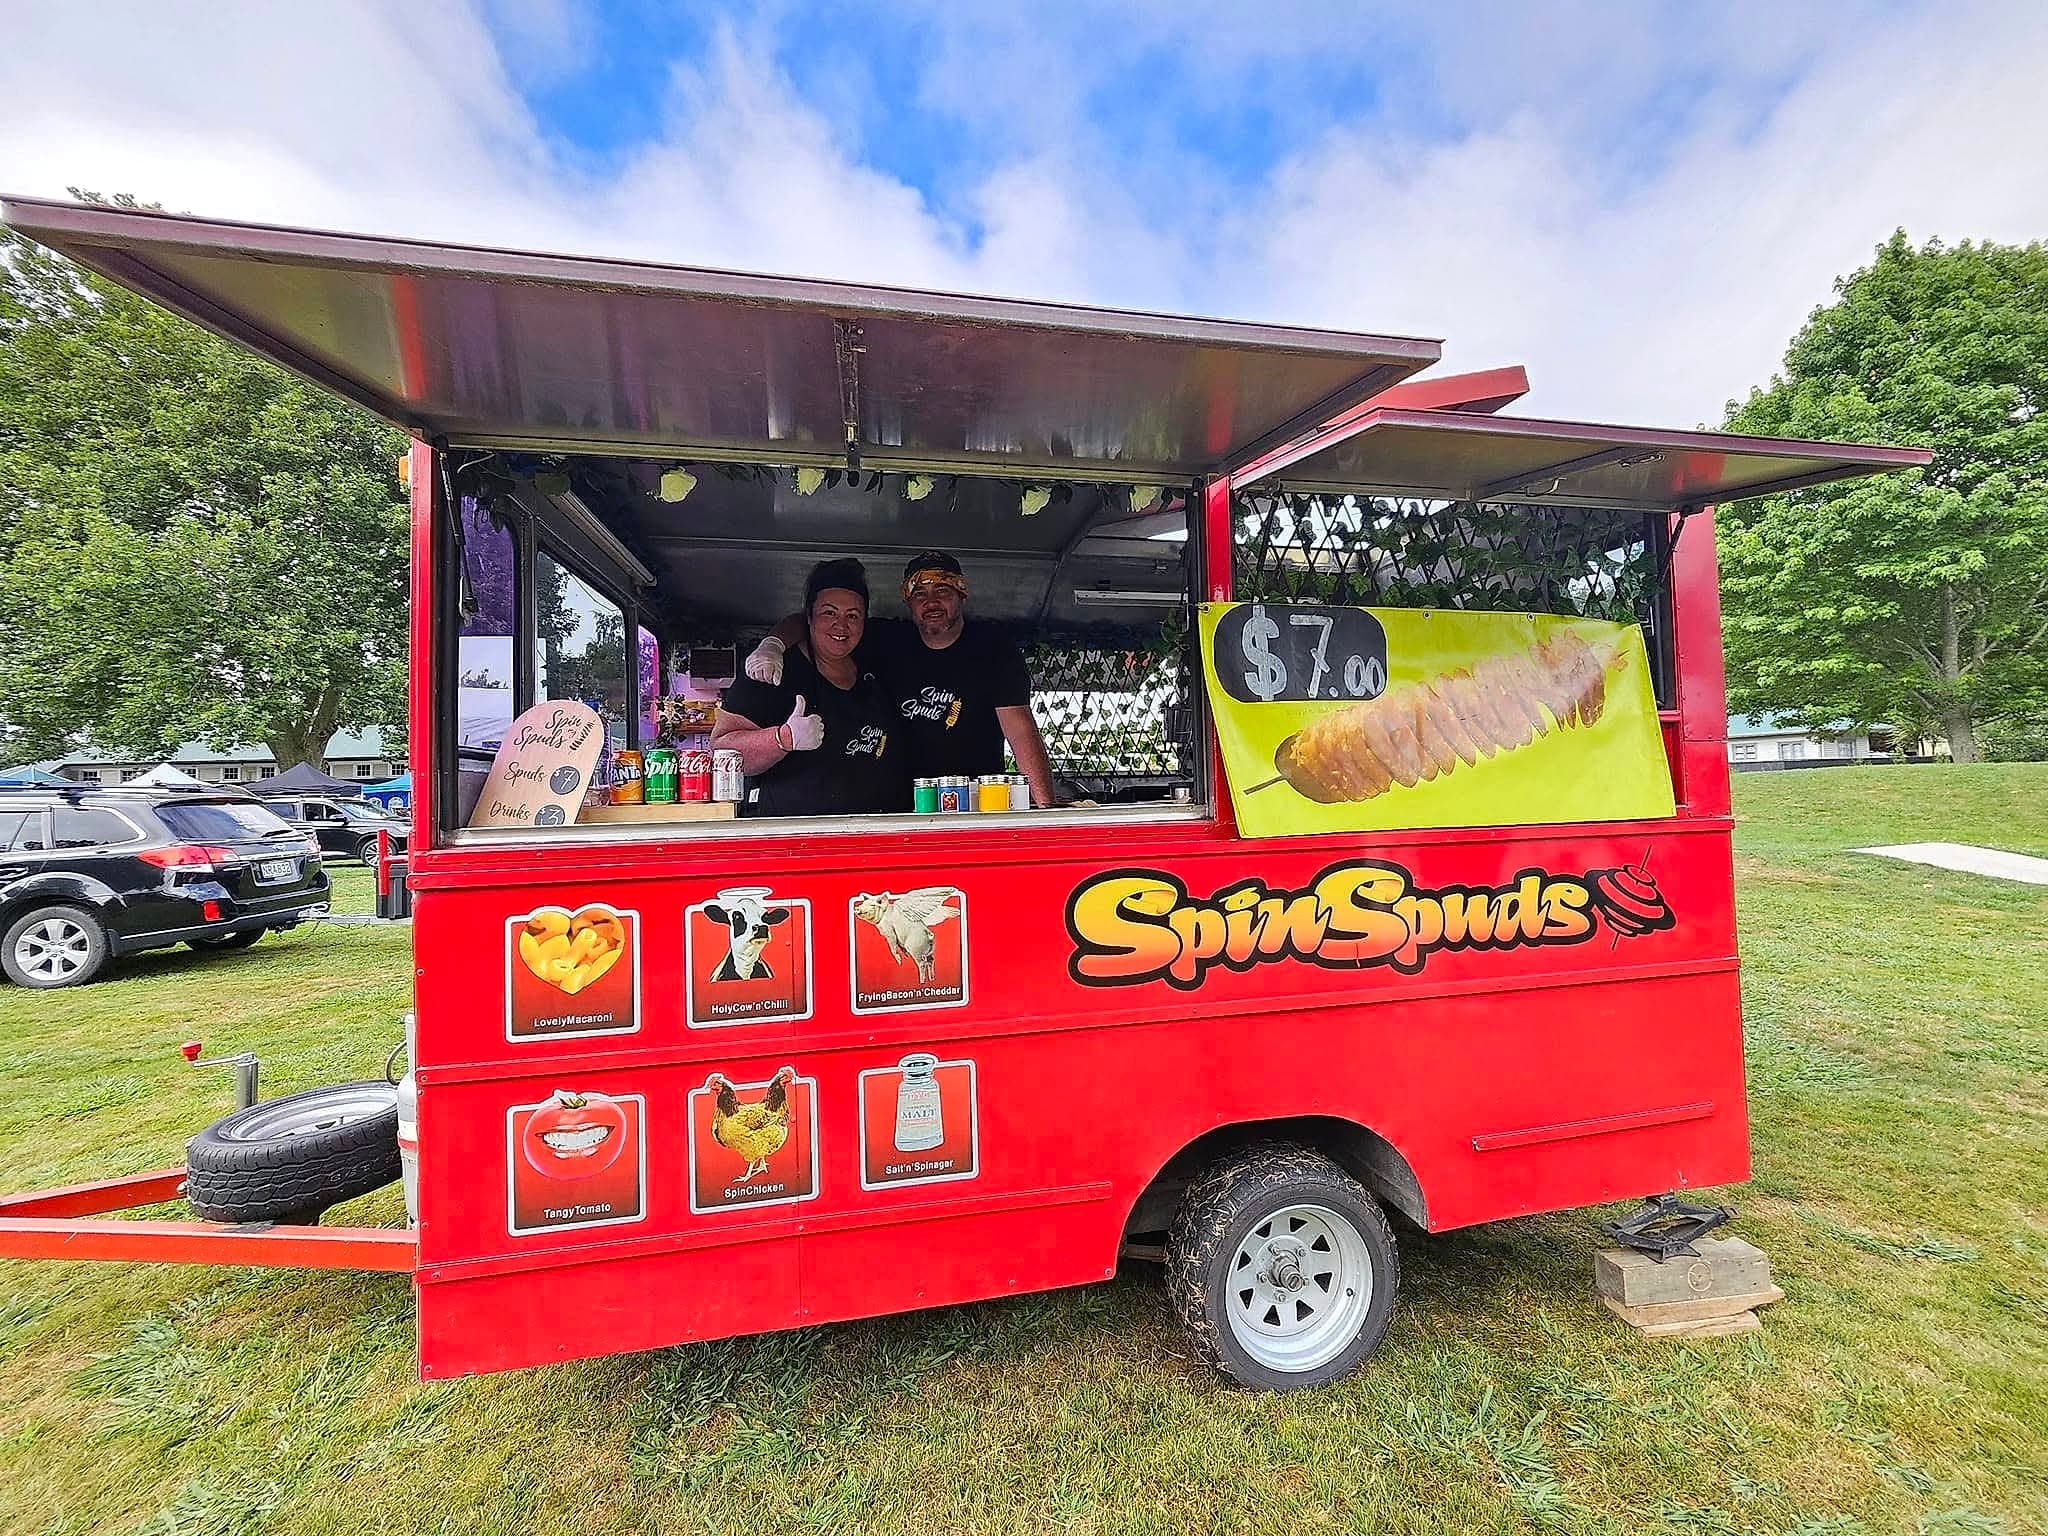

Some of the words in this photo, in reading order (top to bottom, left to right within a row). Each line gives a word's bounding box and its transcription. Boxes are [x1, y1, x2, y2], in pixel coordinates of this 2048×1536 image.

[1242, 604, 1386, 700] $7.00
[920, 686, 956, 706] Spin
[901, 698, 944, 720] Spuds
[545, 709, 582, 735] Spin
[513, 725, 567, 751] Spuds
[860, 724, 883, 742] Spin
[844, 738, 875, 756] Spuds
[503, 761, 548, 787] Spuds
[489, 800, 531, 821] Drinks
[533, 1012, 613, 1028] LovelyMacaroni
[724, 1182, 784, 1200] SpinChicken
[544, 1202, 611, 1220] TangyTomato
